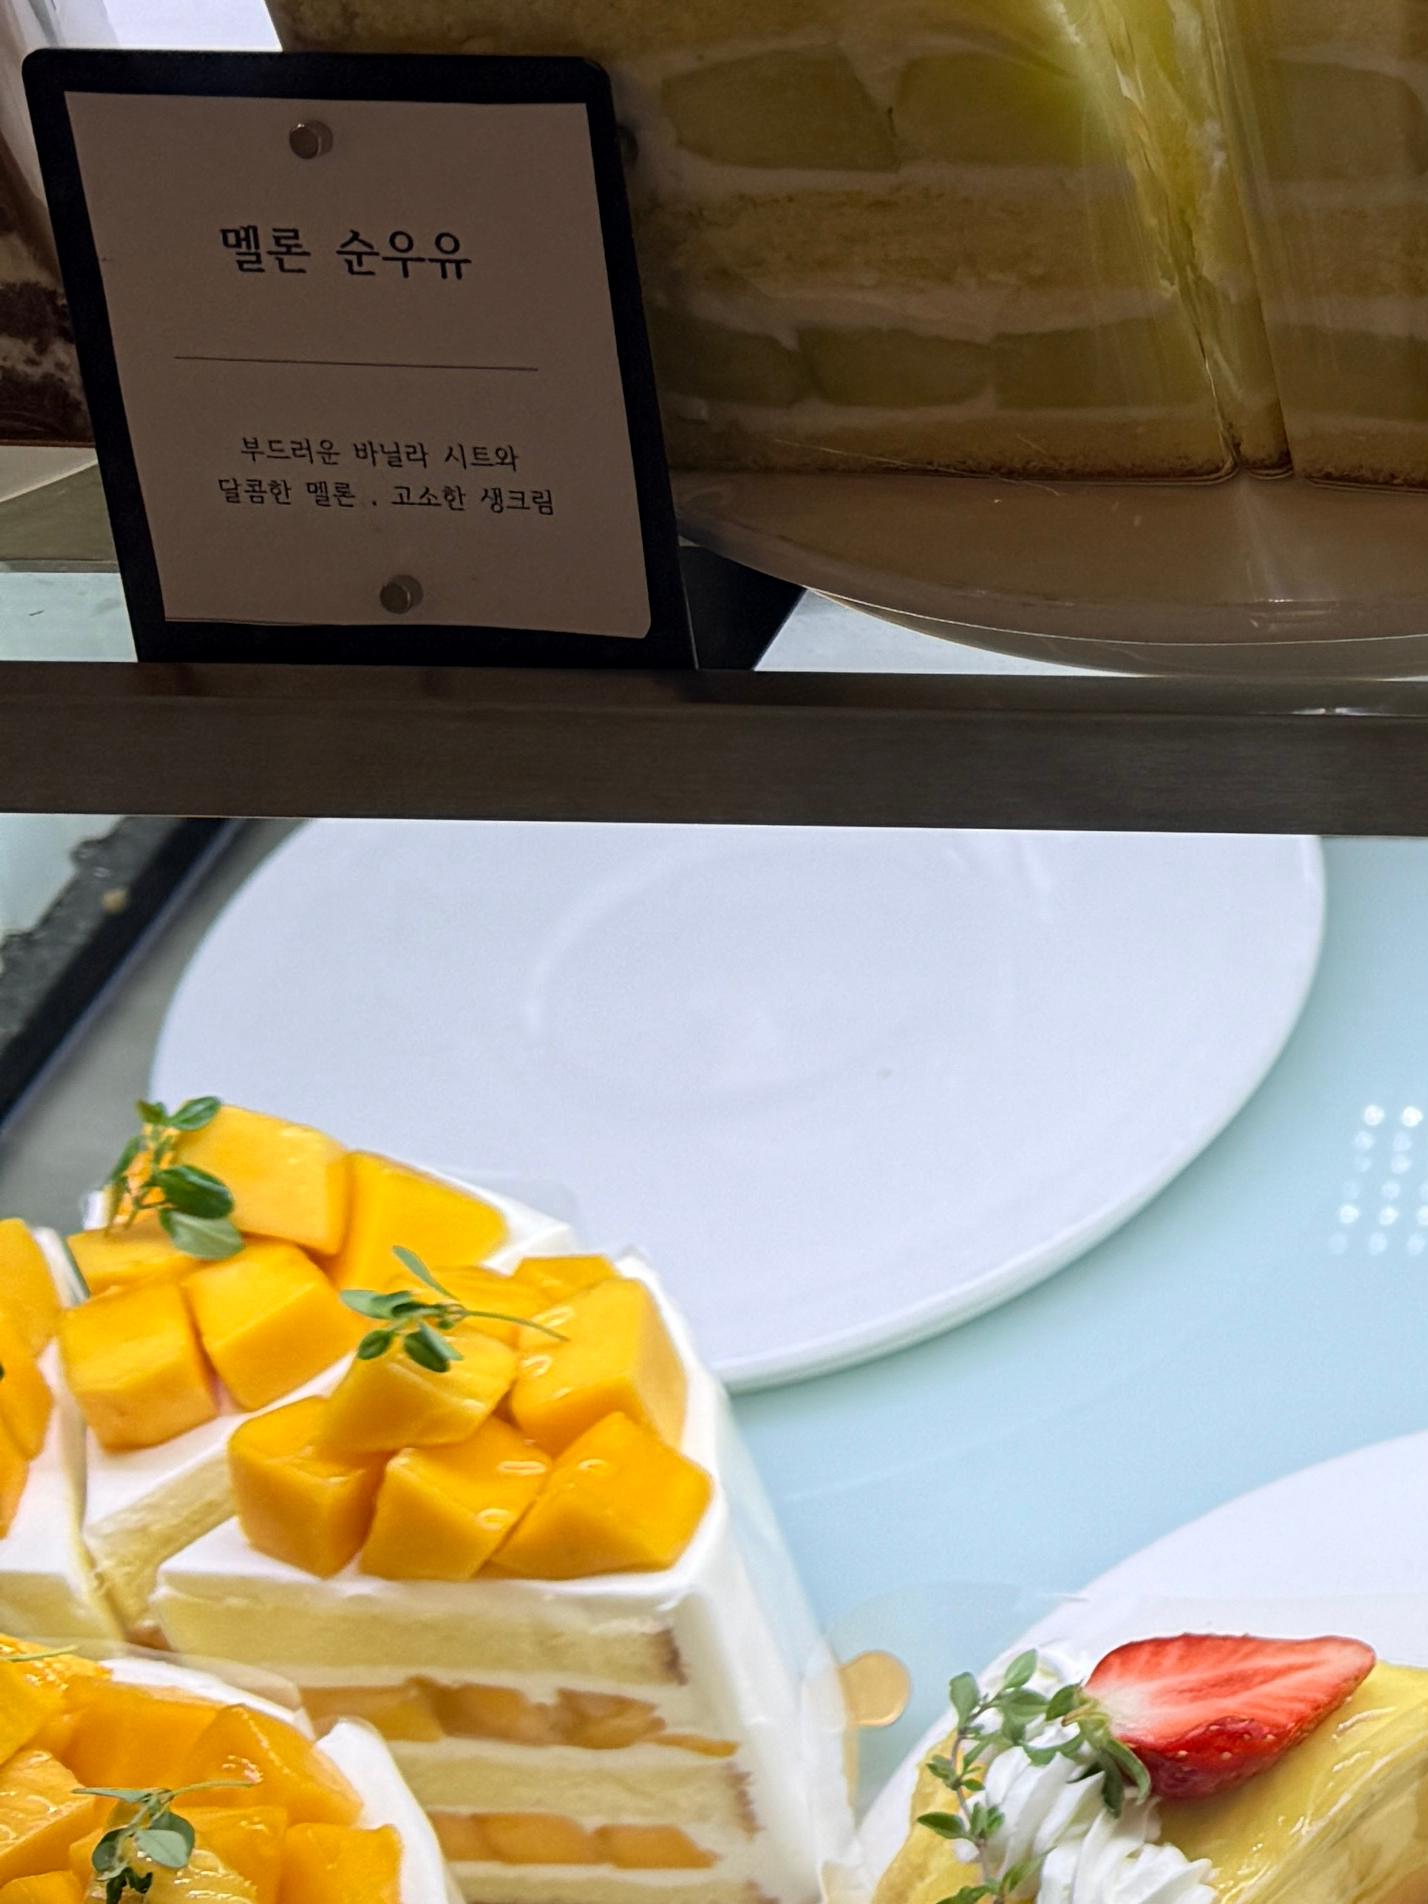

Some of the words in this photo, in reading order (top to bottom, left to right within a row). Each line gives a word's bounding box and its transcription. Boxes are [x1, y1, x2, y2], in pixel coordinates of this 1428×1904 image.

[219, 224, 312, 274] 멜론
[335, 228, 473, 281] 순우유
[240, 436, 341, 466] 부드러운
[352, 439, 429, 470] 바닐라
[444, 442, 519, 473] 시트와
[217, 477, 292, 506] 달콤한
[305, 480, 357, 508] 멜론
[391, 484, 467, 512] 고소한
[480, 487, 554, 516] 생크림
